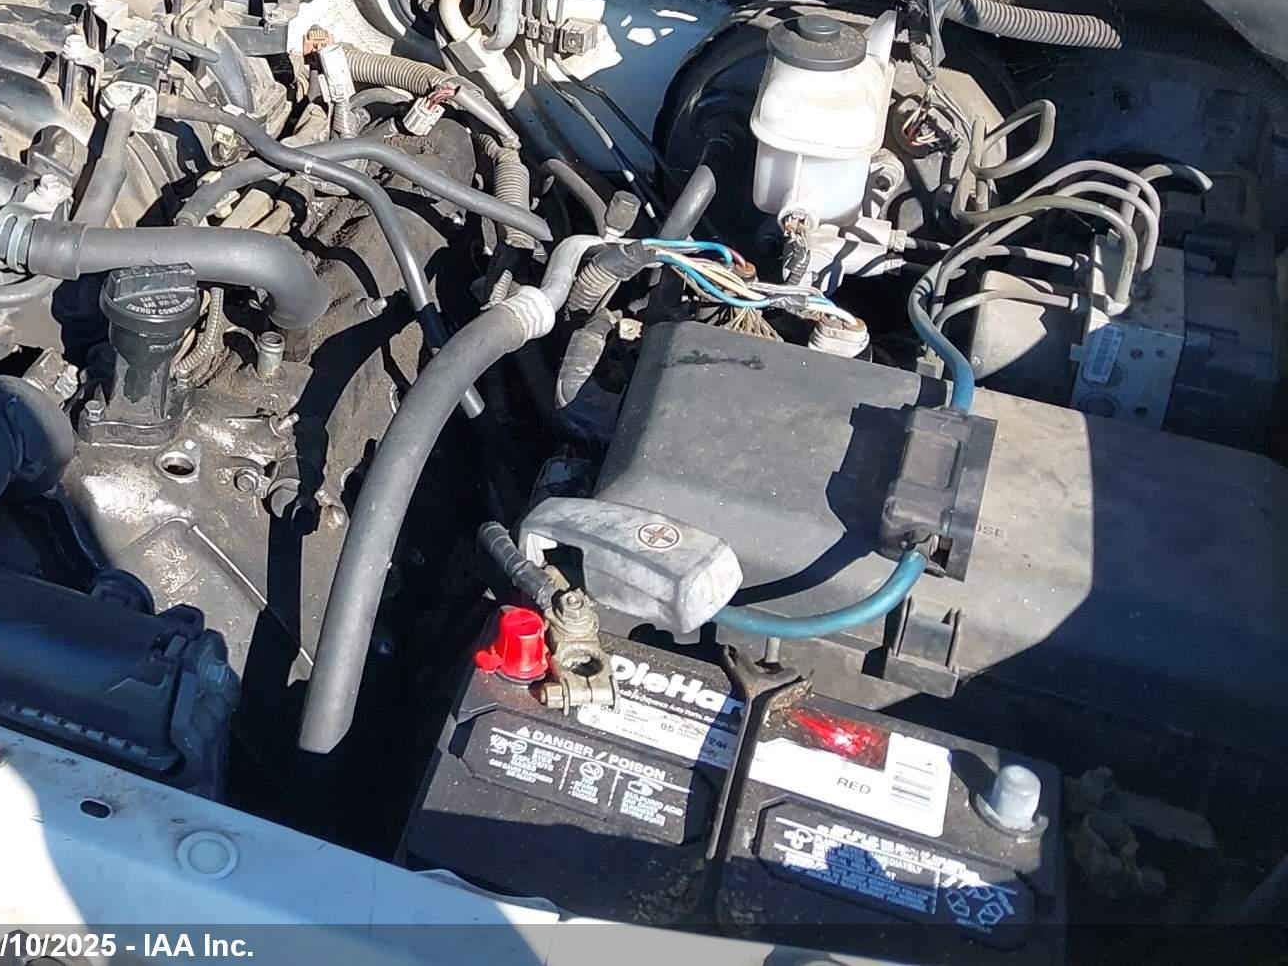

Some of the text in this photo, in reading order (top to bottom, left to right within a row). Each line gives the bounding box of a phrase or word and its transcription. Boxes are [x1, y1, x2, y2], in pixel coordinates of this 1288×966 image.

[126, 303, 156, 314] ENERGY
[611, 654, 745, 716] DieHar
[533, 730, 594, 758] DANGER
[609, 754, 667, 779] POISON
[836, 776, 871, 795] RED
[662, 803, 684, 816] ACID
